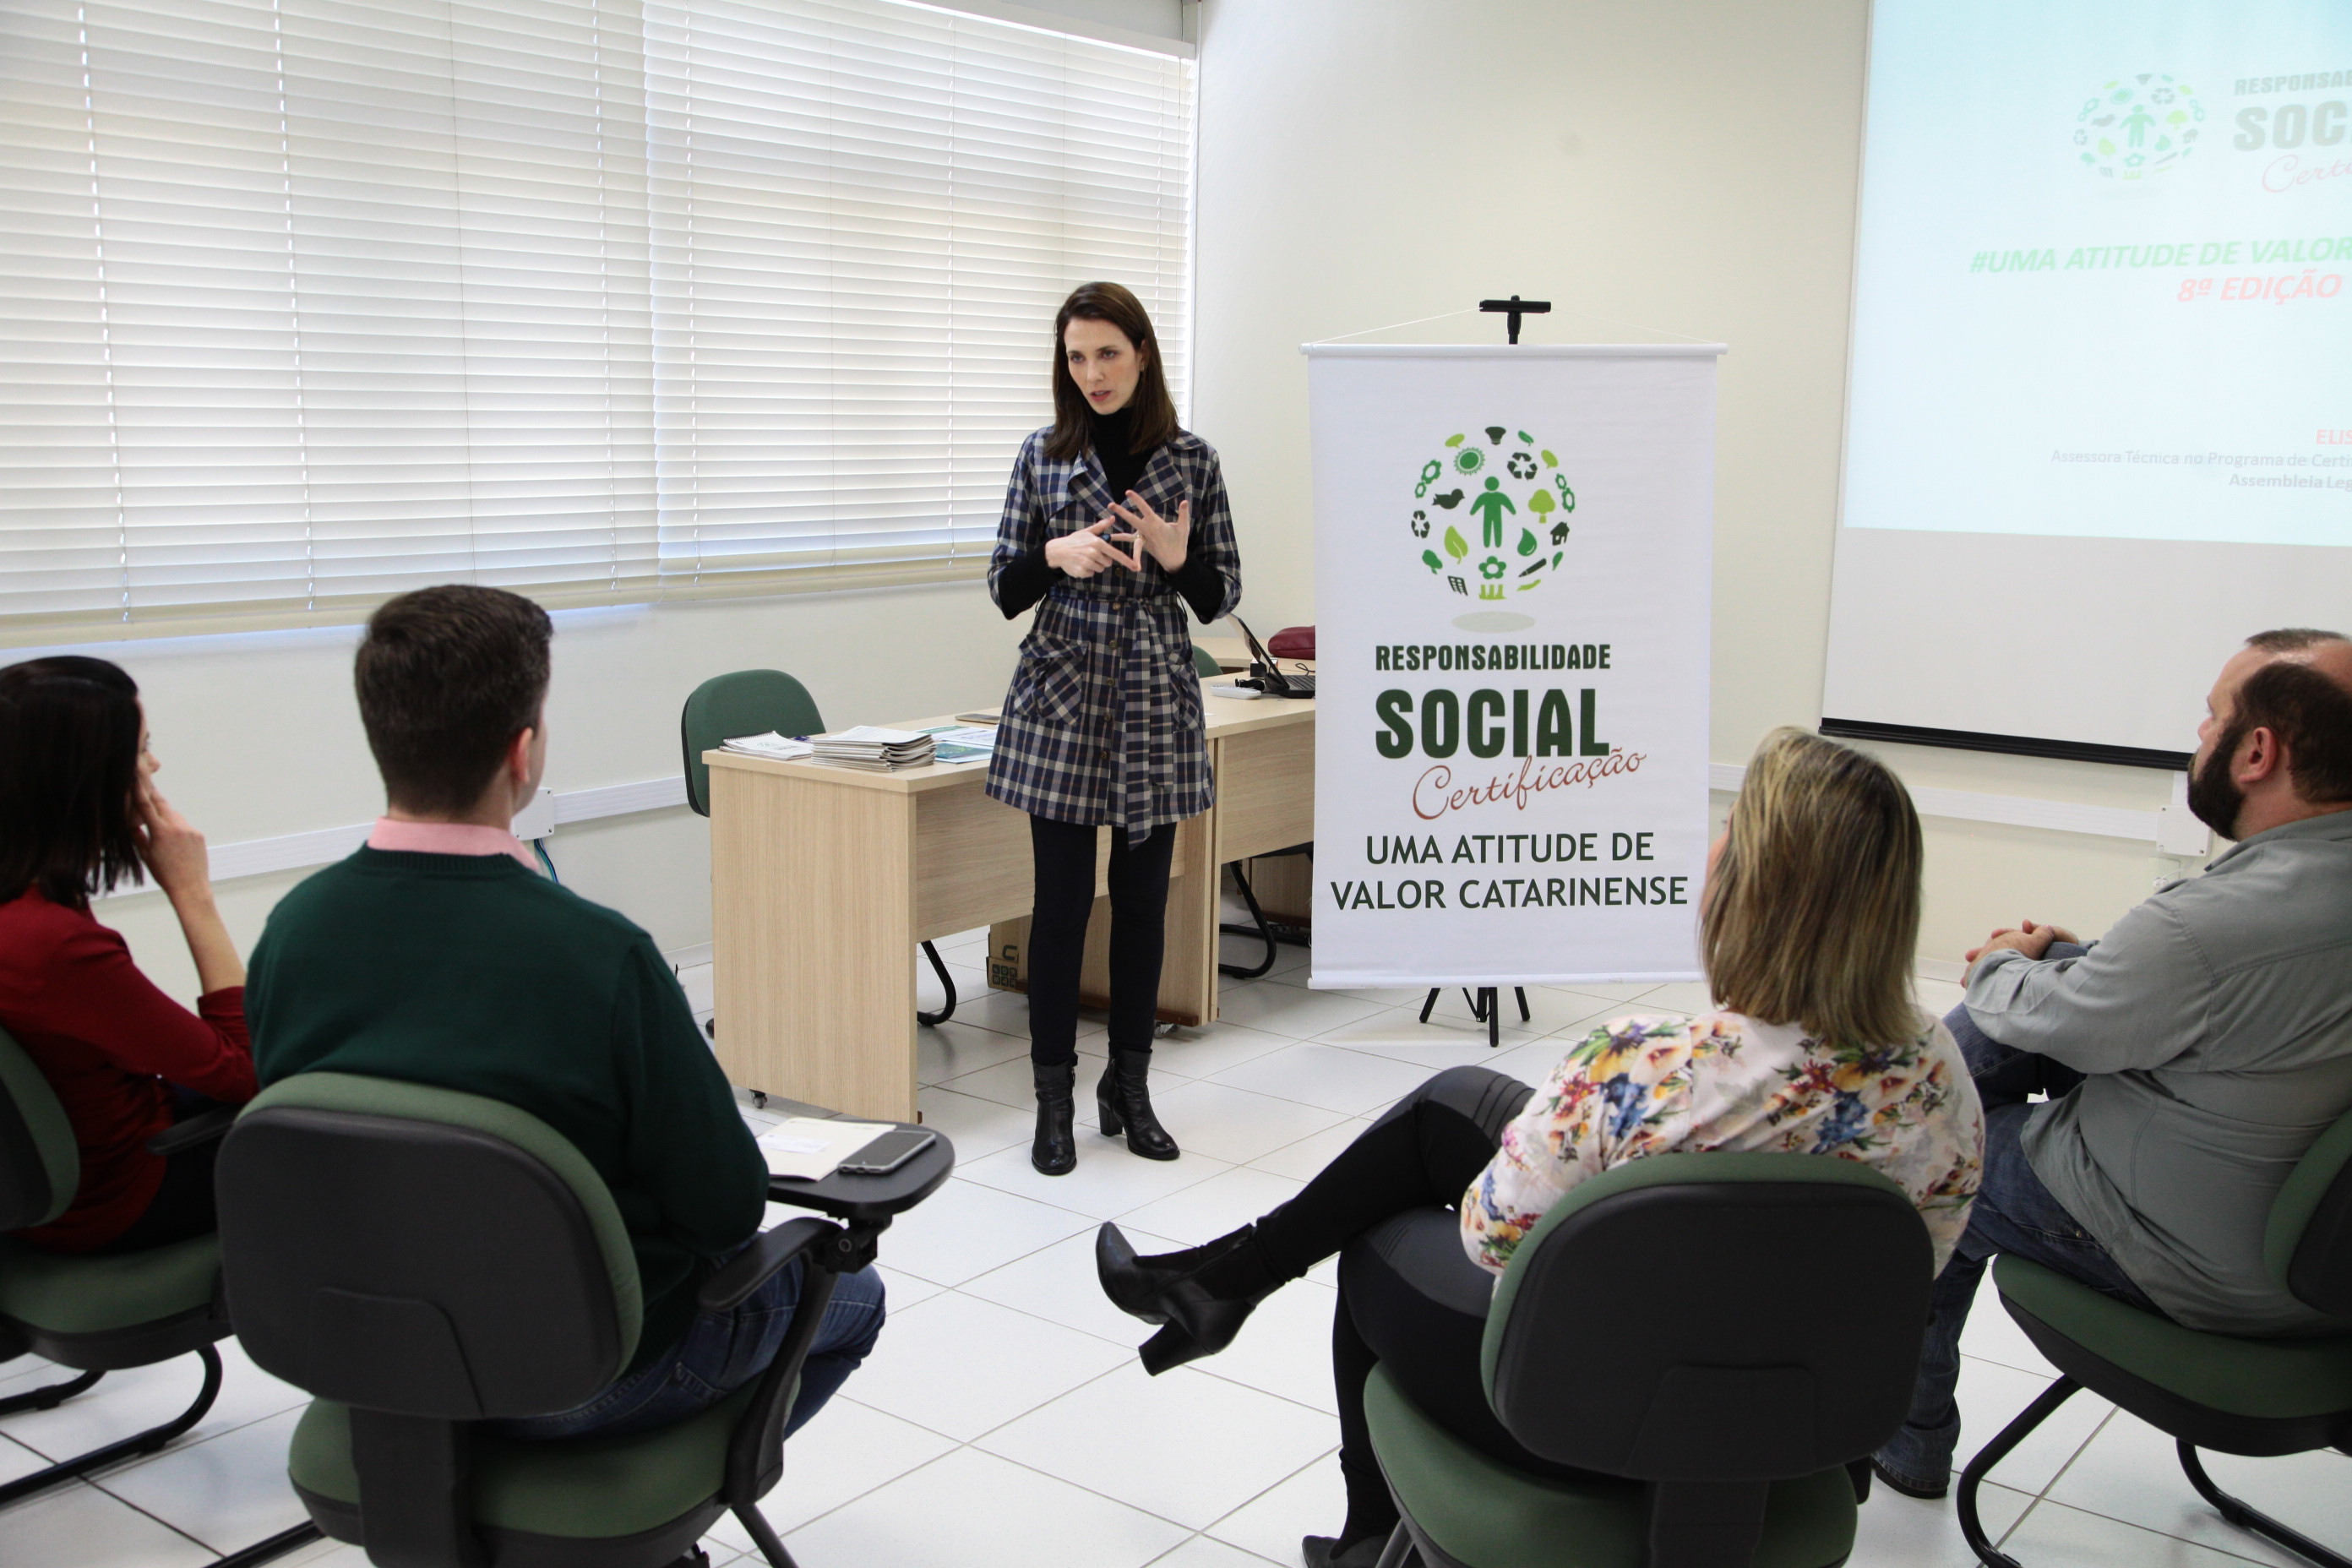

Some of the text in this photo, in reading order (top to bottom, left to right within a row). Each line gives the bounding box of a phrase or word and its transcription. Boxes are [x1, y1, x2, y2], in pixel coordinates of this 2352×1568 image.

[2235, 100, 2352, 150] SOC
[1970, 236, 2352, 274] #UMA ATITUDE DE VALOR
[2176, 269, 2342, 306] 8ª EDIÇÃO
[2316, 428, 2352, 445] ELIS
[2050, 449, 2121, 464] Assessora
[2125, 449, 2180, 465] Técnica
[2184, 455, 2204, 466] no
[2208, 451, 2284, 470] Programa
[2287, 453, 2306, 467] de
[2229, 473, 2352, 493] Assembleia Leg
[1375, 644, 1611, 672] RESPONSABILIDADE
[1375, 688, 1610, 760] SOCIAL
[1413, 747, 1647, 820] Certificação
[1366, 831, 1654, 865] UMA ATITUDE DE
[1330, 875, 1689, 911] VALOR CATARINENSE
